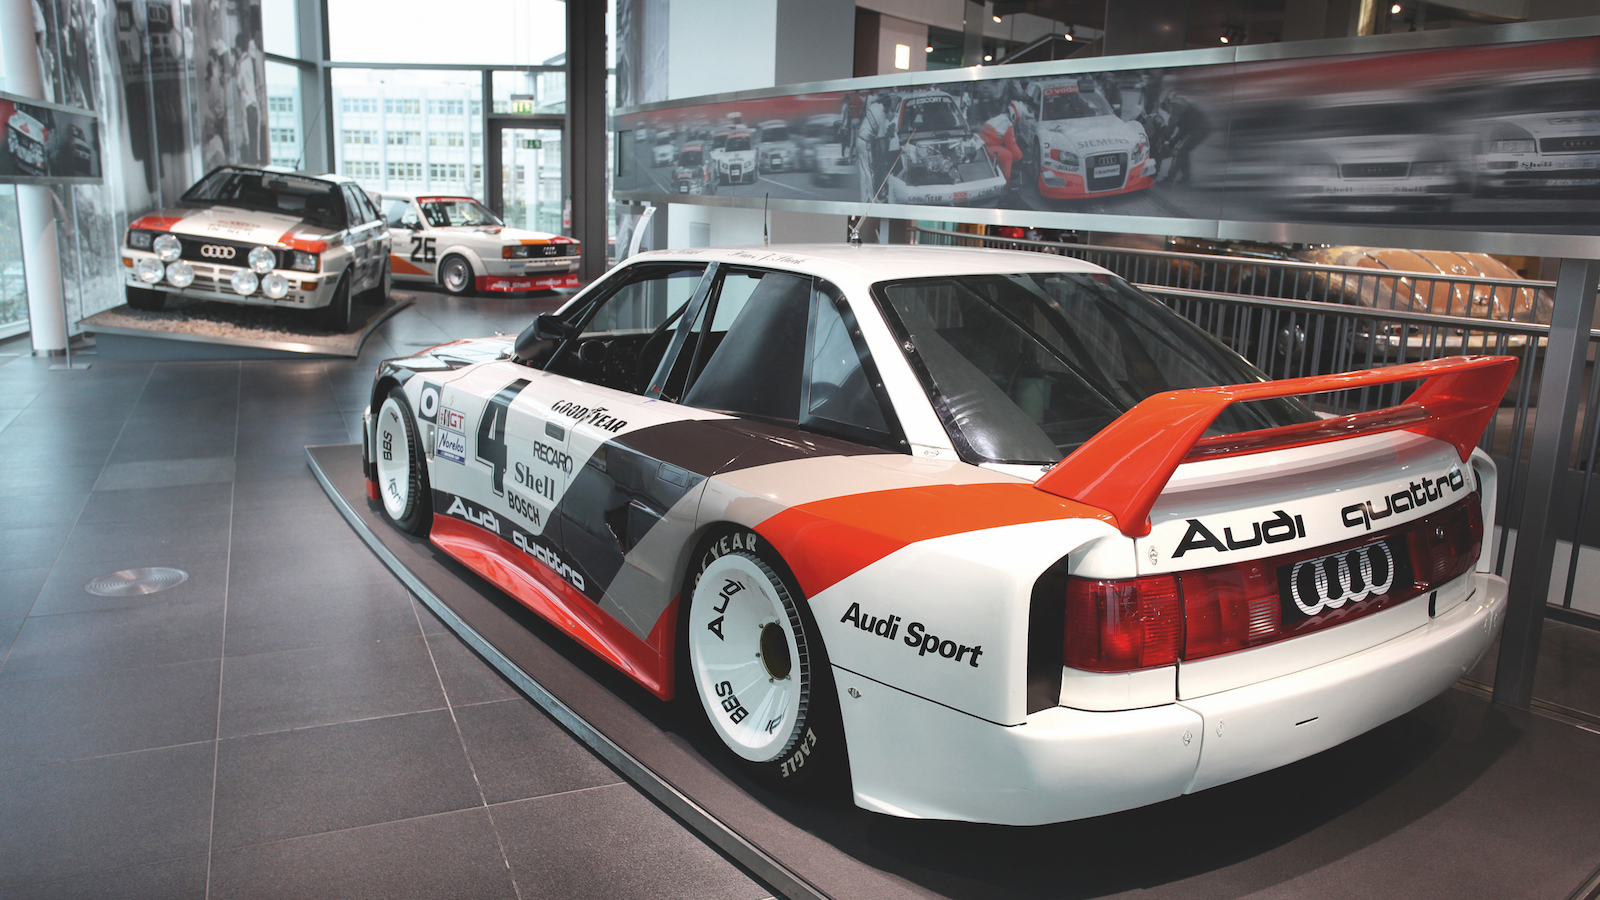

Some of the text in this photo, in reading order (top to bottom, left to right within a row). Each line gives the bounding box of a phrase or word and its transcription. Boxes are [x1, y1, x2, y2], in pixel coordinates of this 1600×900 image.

[1054, 86, 1079, 94] voda
[1077, 138, 1130, 149] SIEMENS
[411, 237, 437, 263] 26
[551, 400, 627, 433] GOODYEAR
[383, 430, 392, 461] BBS
[438, 432, 464, 453] Norelco
[475, 378, 532, 498] 4
[533, 441, 573, 475] RECARO
[514, 461, 555, 502] Shell
[507, 490, 541, 527] BOSCH
[1171, 468, 1464, 558] Audi quattro
[446, 496, 585, 592] Audi quattro
[707, 579, 746, 641] Audi
[840, 602, 984, 668] Audi Sport
[715, 680, 749, 725] BBS
[780, 727, 817, 778] EAGLE
